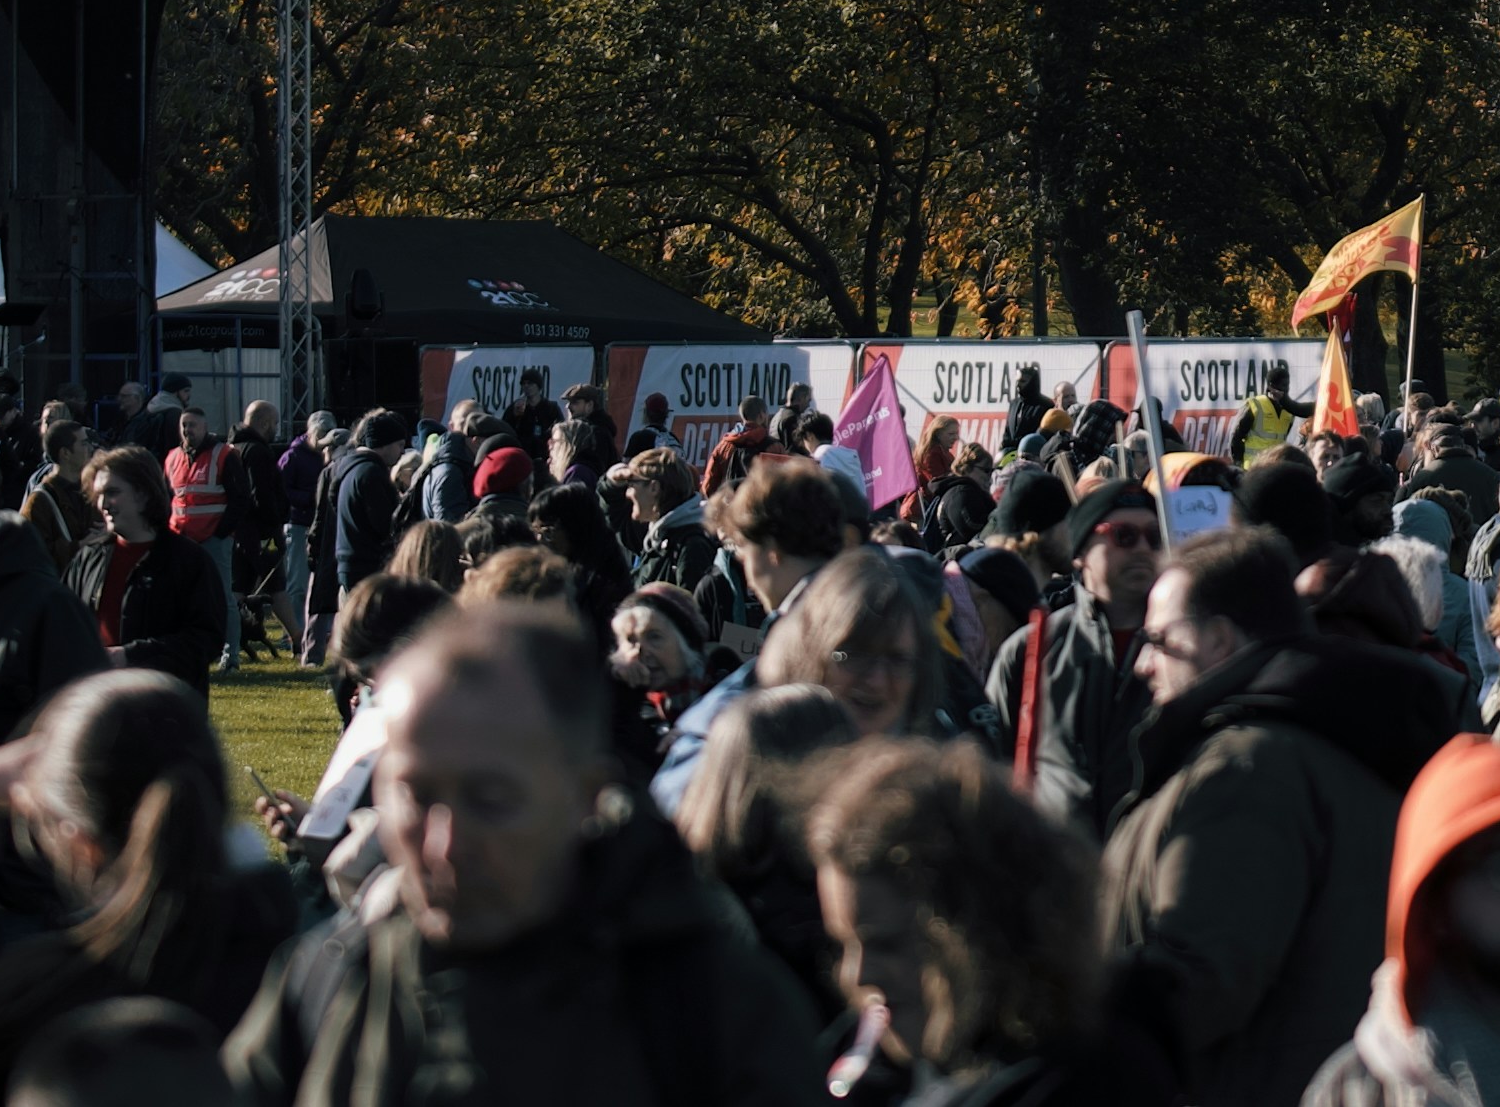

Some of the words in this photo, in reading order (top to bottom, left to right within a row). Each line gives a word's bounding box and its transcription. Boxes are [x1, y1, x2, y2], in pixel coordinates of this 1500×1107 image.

[164, 324, 265, 339] www.21ccgroucom
[524, 323, 546, 336] 0131
[549, 324, 565, 337] 331
[567, 326, 590, 339] 4509
[680, 362, 791, 407] SCOTLAND
[933, 361, 1041, 404] SCOTLA
[1180, 359, 1290, 402] SCOTLA
